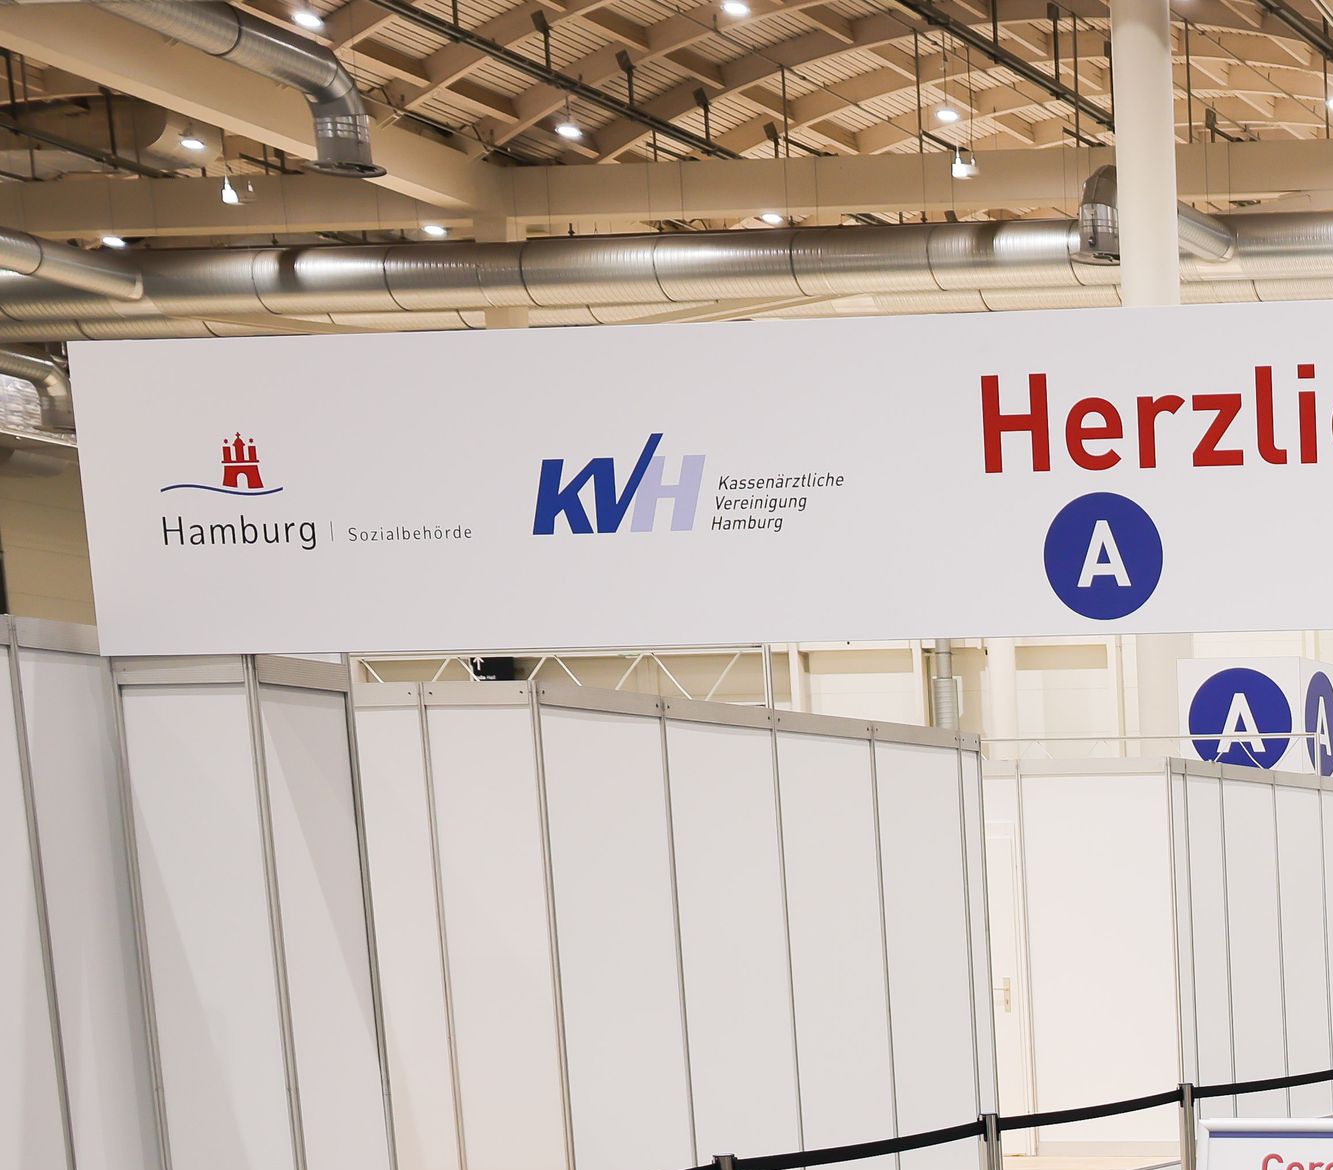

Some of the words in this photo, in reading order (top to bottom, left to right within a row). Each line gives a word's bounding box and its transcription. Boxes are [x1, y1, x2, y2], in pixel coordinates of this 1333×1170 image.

[532, 432, 706, 536] KVH
[714, 494, 808, 514] Vereinigung
[719, 473, 844, 490] Kassenärztliche
[162, 514, 317, 550] Hamburg
[348, 524, 473, 542] Sozialbehörde
[711, 515, 784, 533] Hamburg
[1078, 520, 1131, 587] A
[1217, 693, 1265, 753] A
[1315, 696, 1332, 756] A
